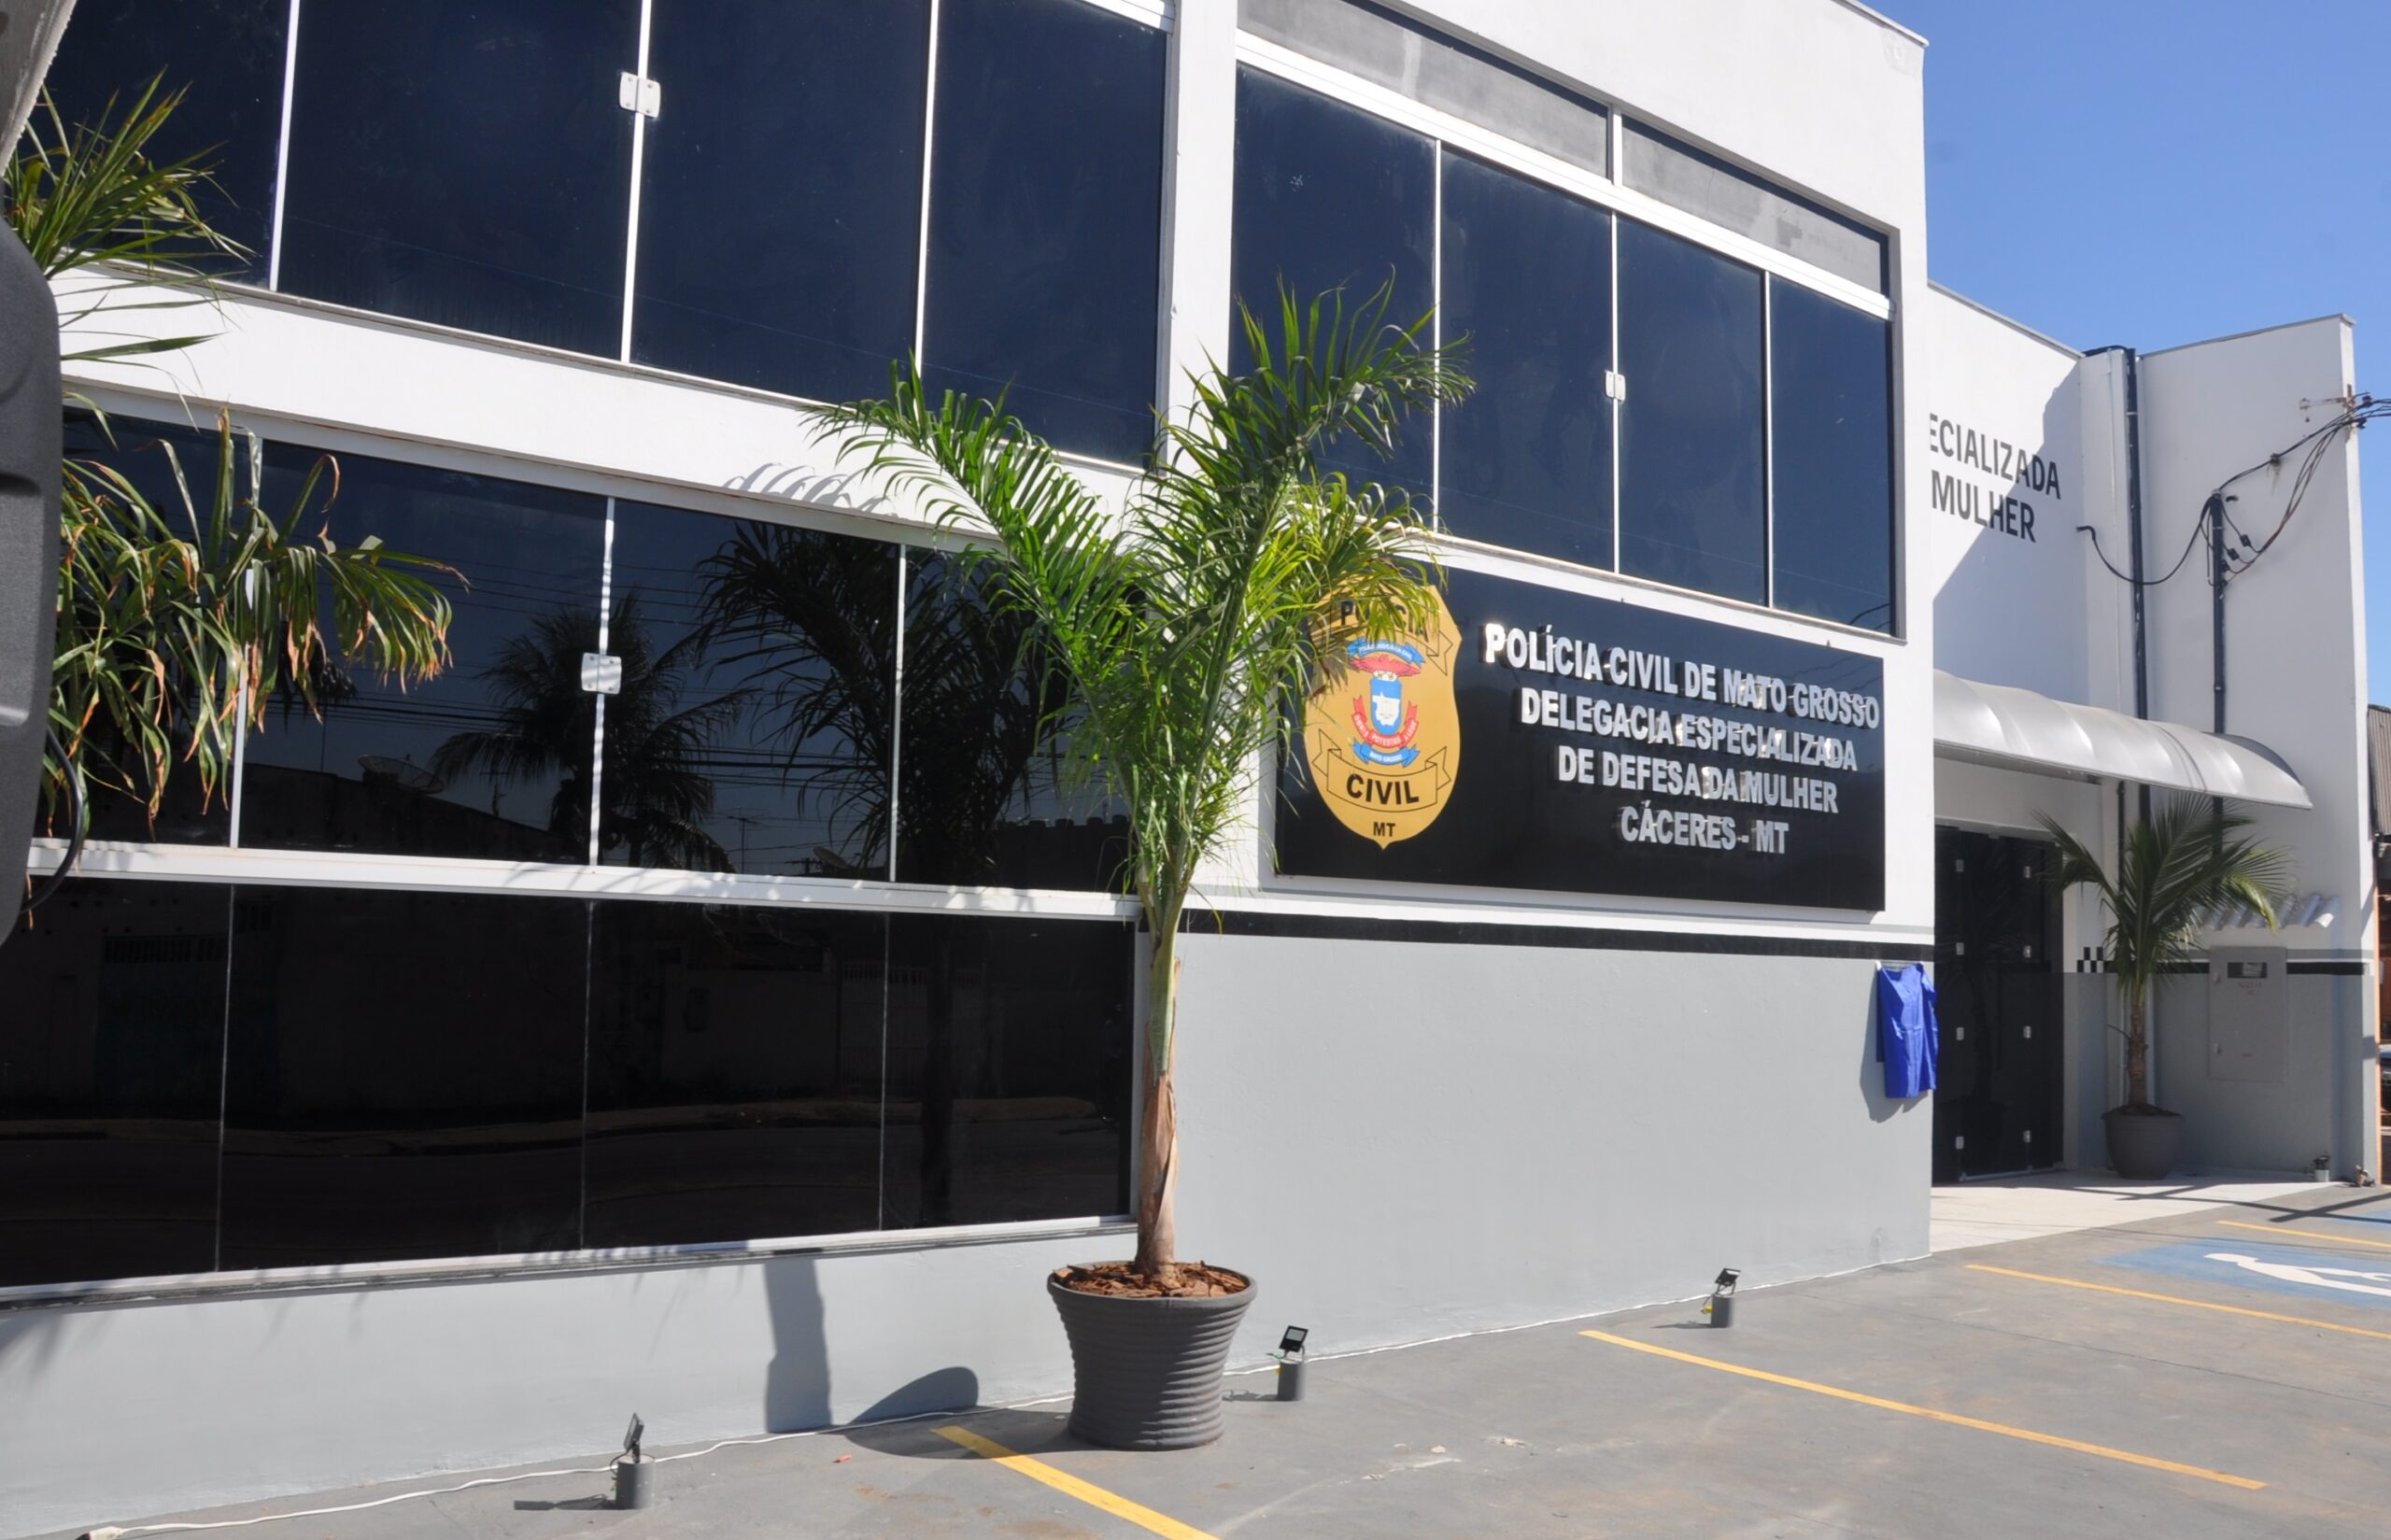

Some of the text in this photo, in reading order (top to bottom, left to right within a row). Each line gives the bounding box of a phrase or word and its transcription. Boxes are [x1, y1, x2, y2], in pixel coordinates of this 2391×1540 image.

[1931, 469, 2037, 543] MULHER
[1485, 623, 1880, 729] POLÍCIA CIVIL DE MATO GROSSO
[1521, 687, 1858, 771] DELEGACIA ESPECIALIZADA
[1346, 772, 1420, 805] CIVIL
[1558, 745, 1839, 813] DE DEFESA DA MULHER
[1373, 821, 1396, 838] MT
[1620, 799, 1737, 851] CÁCERES
[1756, 819, 1790, 854] MT
